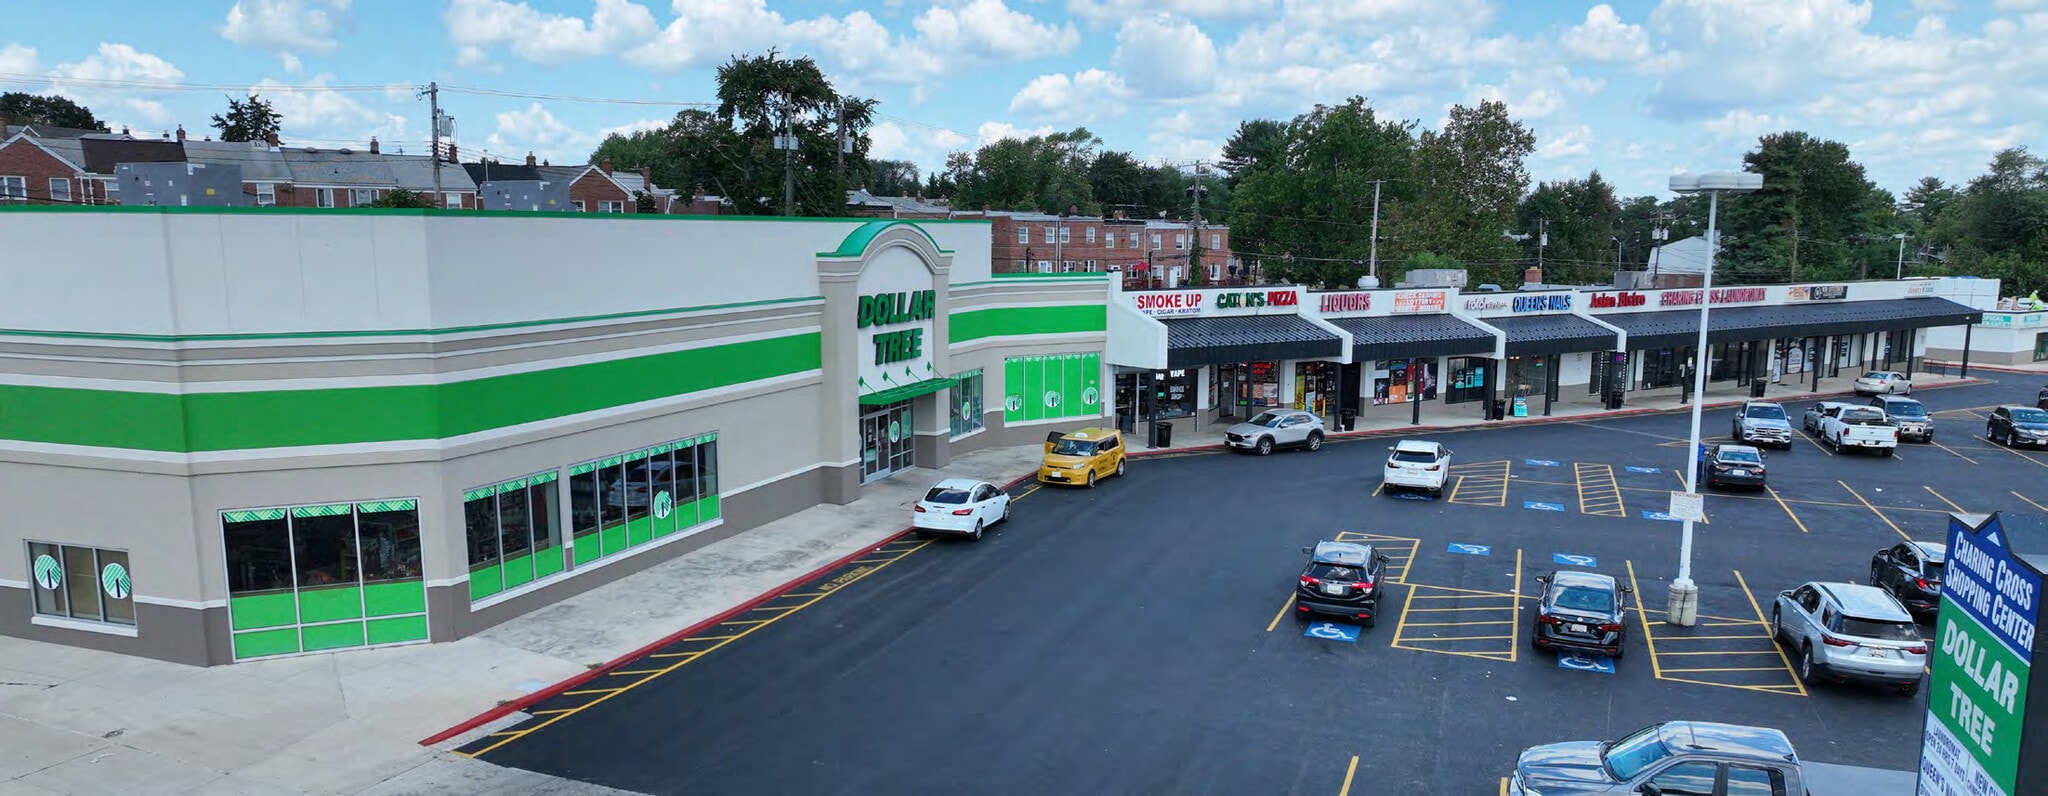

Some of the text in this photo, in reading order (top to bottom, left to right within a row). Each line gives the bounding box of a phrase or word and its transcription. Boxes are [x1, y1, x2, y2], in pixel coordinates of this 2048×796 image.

[1137, 293, 1202, 309] SMOKE UP
[1267, 290, 1298, 306] PIZZA
[1321, 293, 1371, 312] LIQUORS
[1548, 295, 1572, 310] NAILS
[1590, 292, 1646, 308] Asian Bistro
[1661, 291, 1694, 306] CHARING
[1721, 288, 1767, 303] LAUNDROMAT
[858, 290, 935, 328] DOLLAR
[873, 328, 923, 365] TREE
[1941, 618, 2020, 716] DOLLAR
[1950, 680, 1996, 757] TREE
[1921, 755, 1945, 792] QUEEN'S
[1974, 770, 1989, 795] NEW
